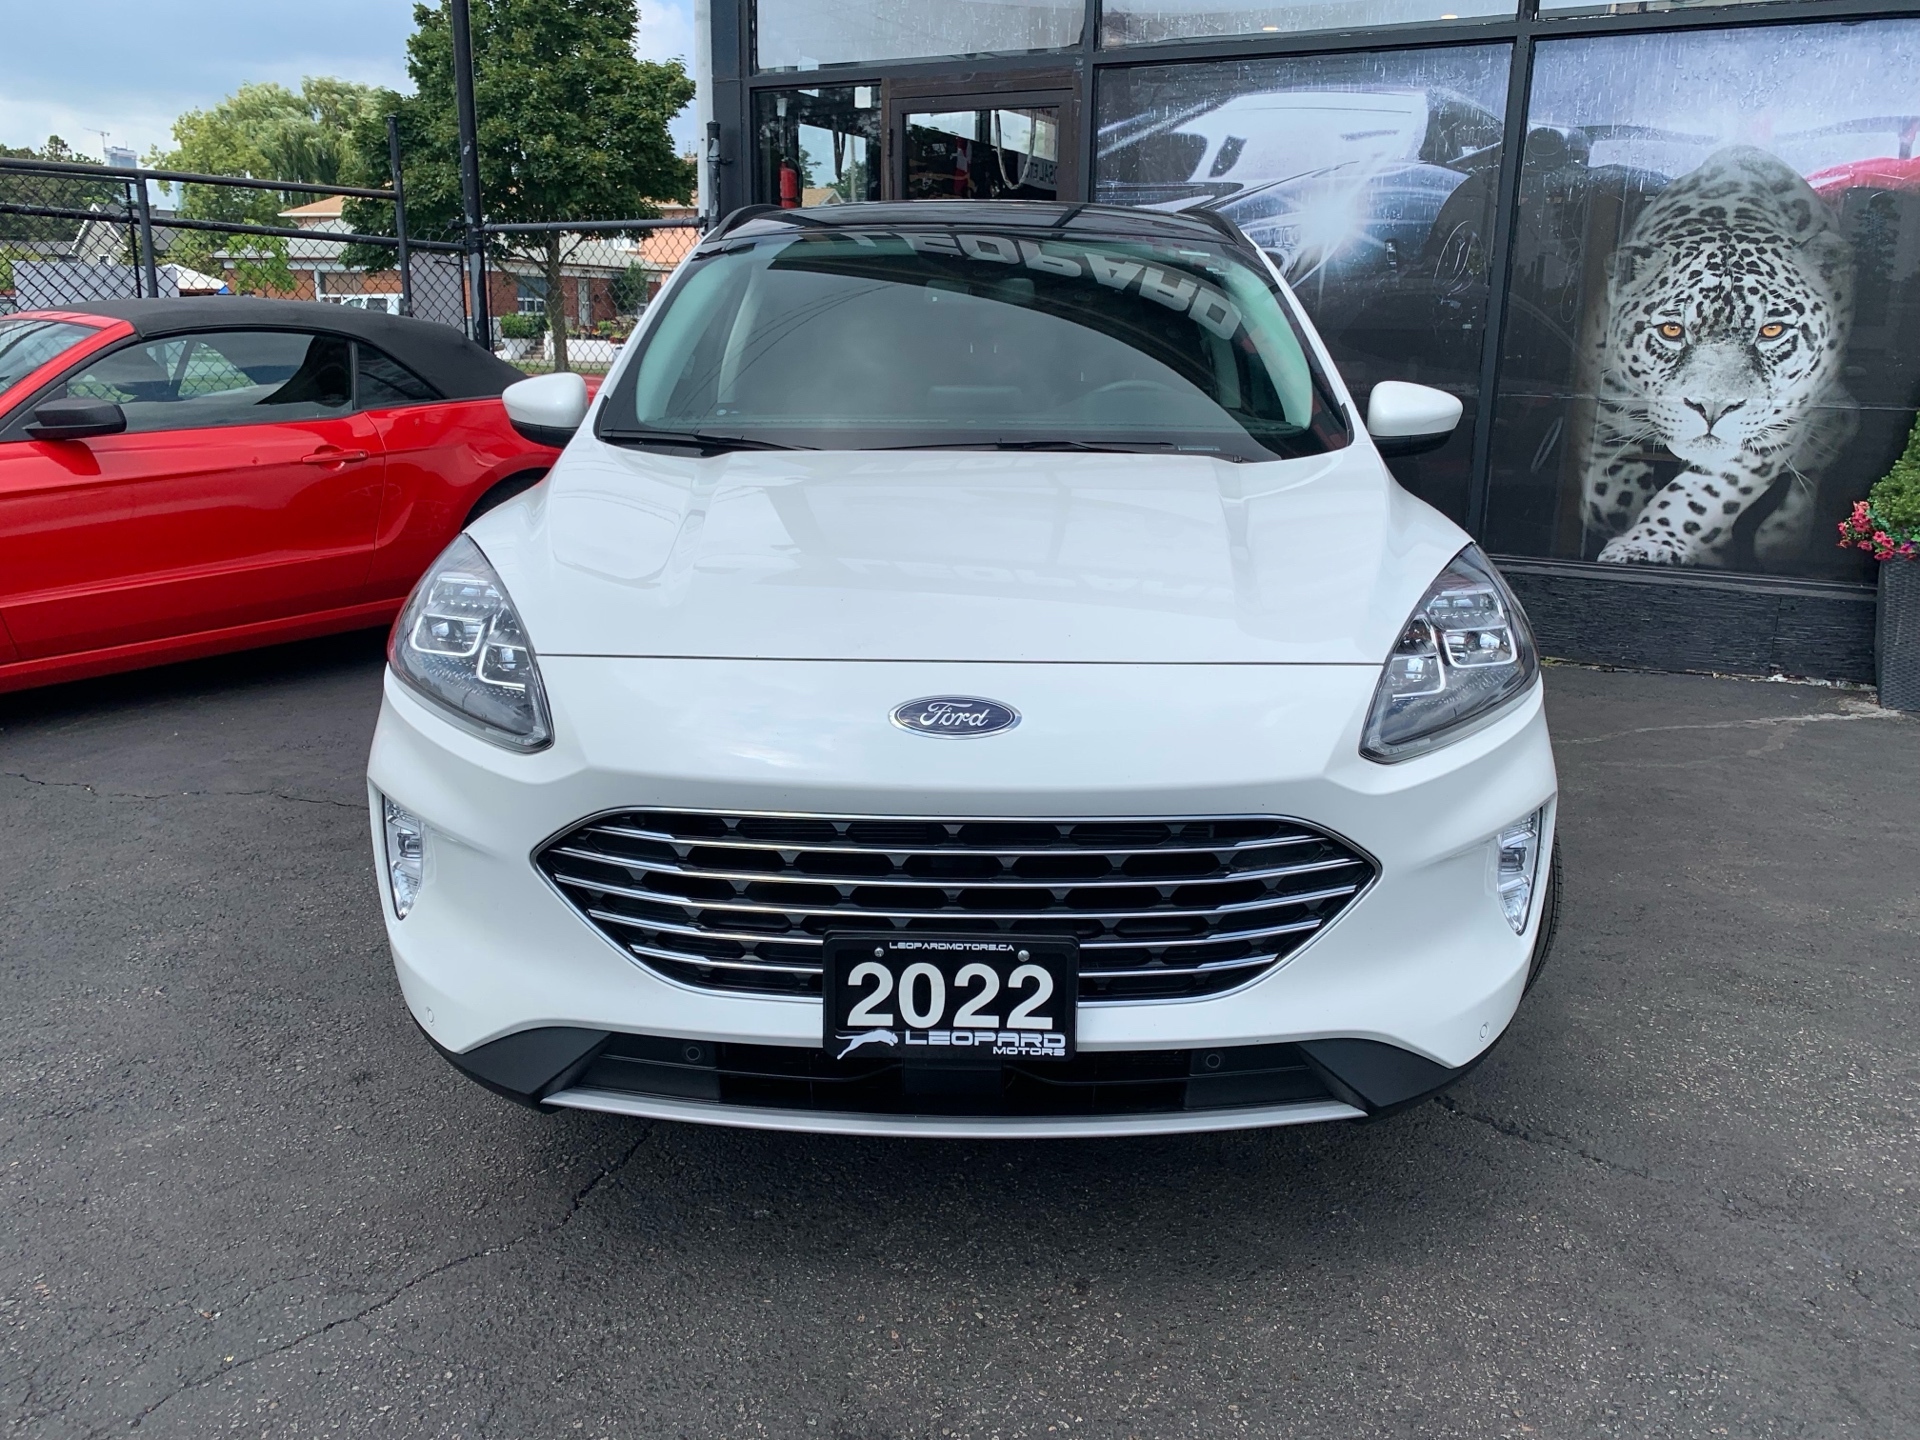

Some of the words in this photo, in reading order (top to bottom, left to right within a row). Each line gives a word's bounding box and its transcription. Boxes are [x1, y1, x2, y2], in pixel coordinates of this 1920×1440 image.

[919, 701, 990, 727] Ford
[889, 942, 1014, 952] LEOPARDMOTORS.CA
[847, 961, 1054, 1030] 2022
[905, 1029, 1066, 1048] LEOPARD
[992, 1046, 1066, 1057] MOTORS
